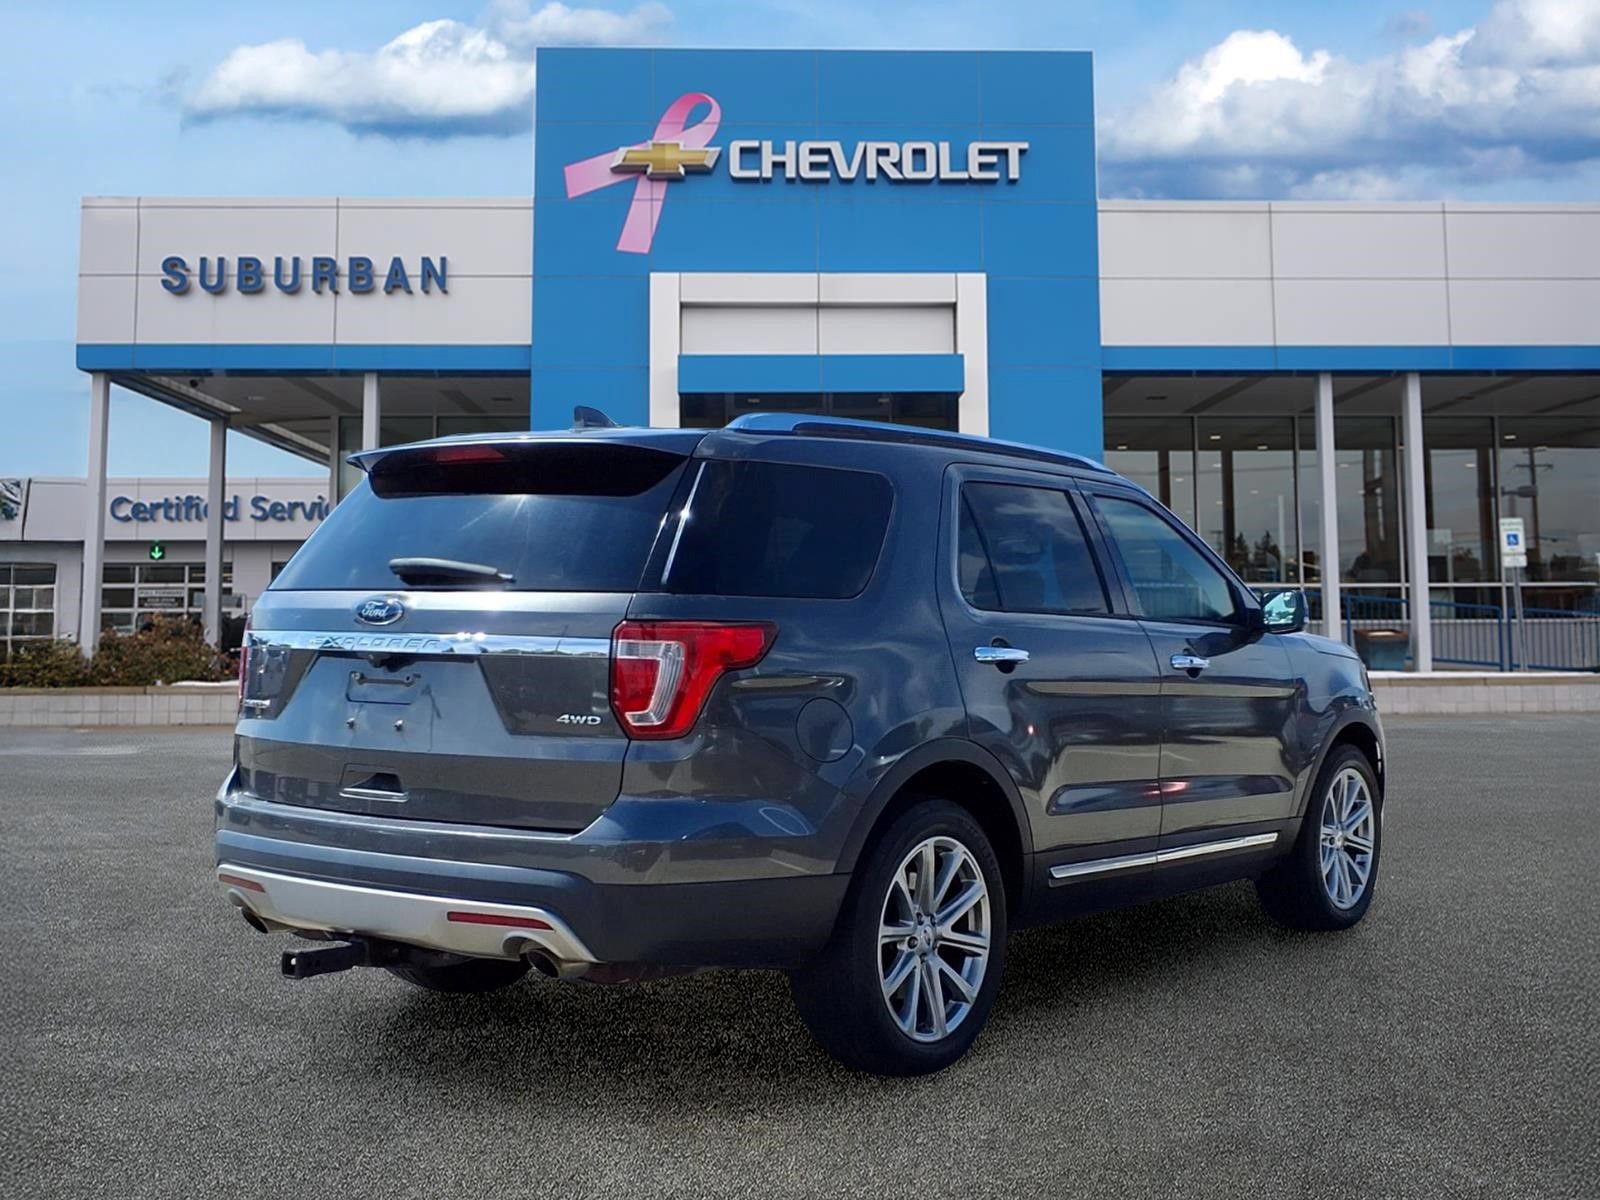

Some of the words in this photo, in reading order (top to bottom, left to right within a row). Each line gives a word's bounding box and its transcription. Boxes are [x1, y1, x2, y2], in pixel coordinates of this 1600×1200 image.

[729, 139, 1029, 181] CHEVROLET
[160, 256, 450, 295] SUBURBAN
[109, 496, 241, 522] Certifid
[361, 600, 390, 617] Ford
[311, 635, 441, 650] EXPLORER
[556, 713, 602, 725] 4WD
